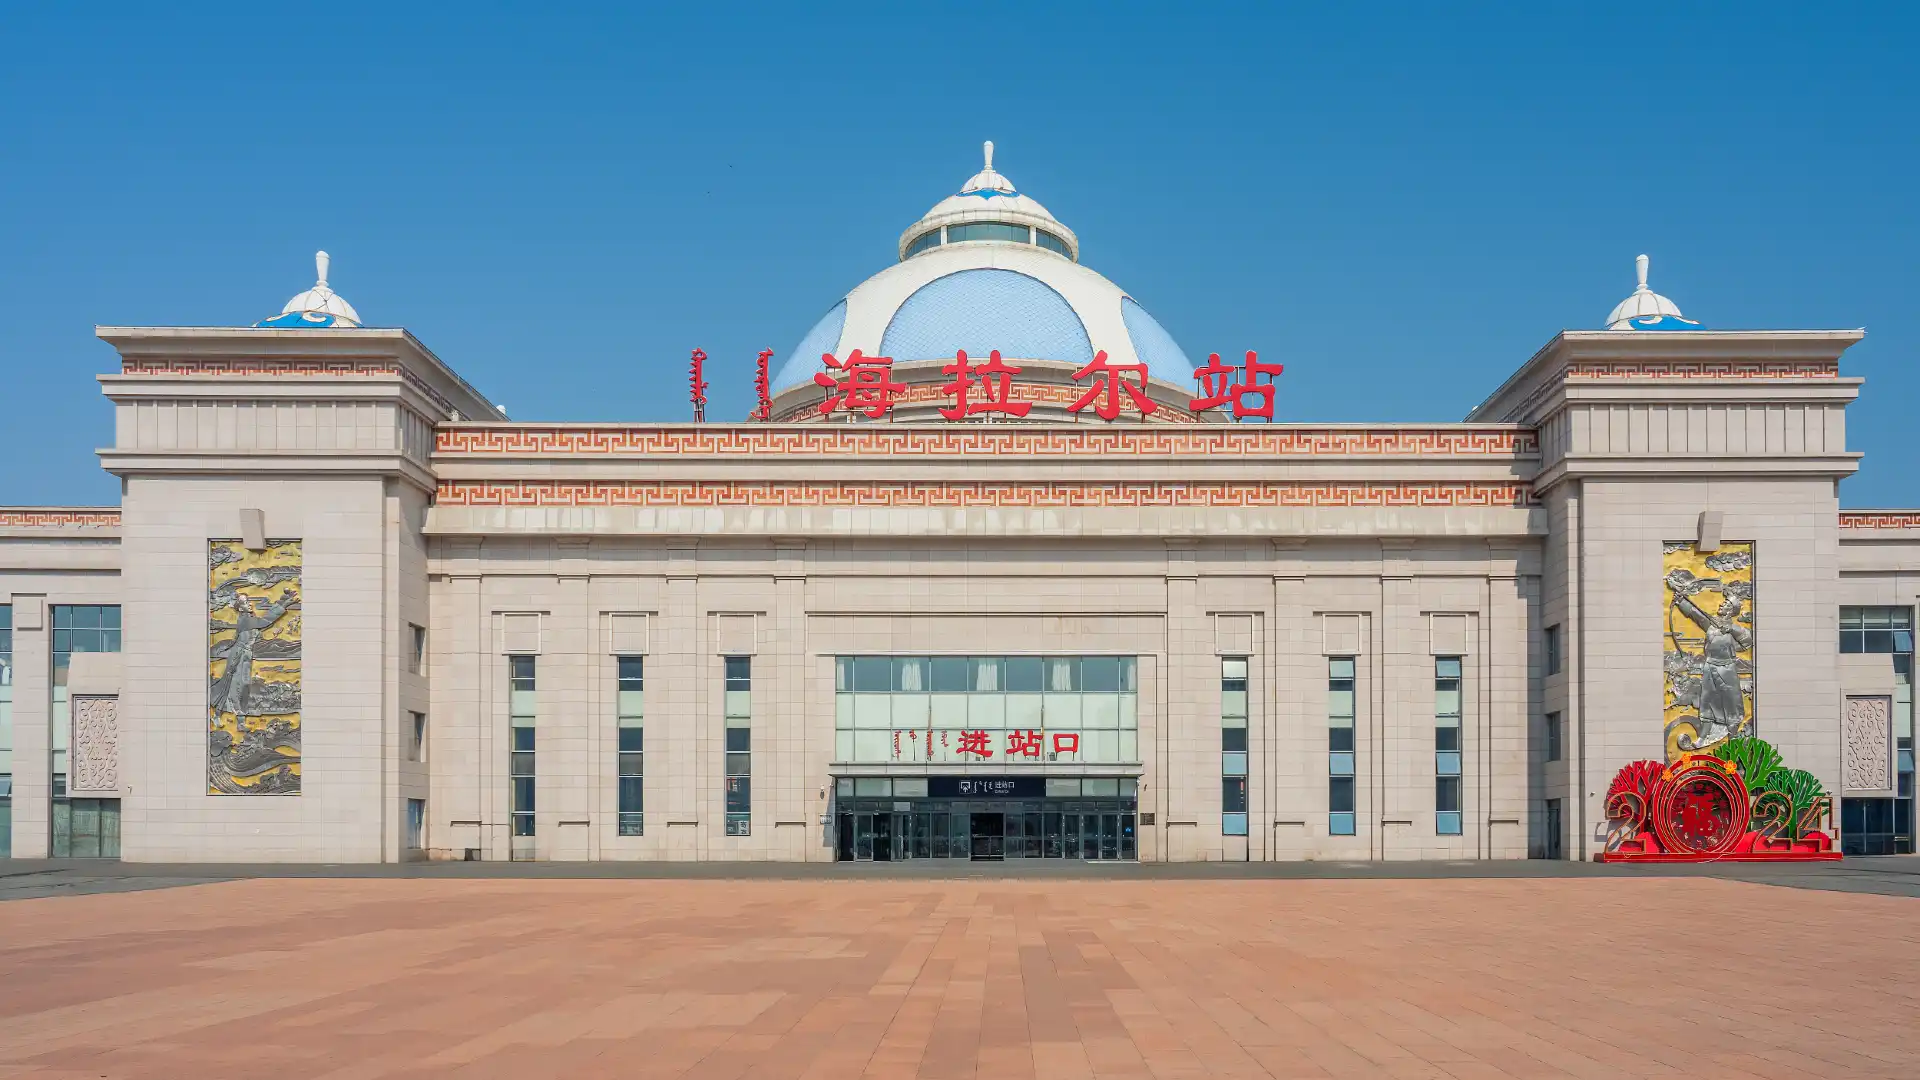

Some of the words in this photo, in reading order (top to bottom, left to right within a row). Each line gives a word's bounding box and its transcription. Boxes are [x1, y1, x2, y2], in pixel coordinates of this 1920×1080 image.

[813, 349, 1283, 421] 海拉尔站
[956, 729, 1080, 758] 进站口
